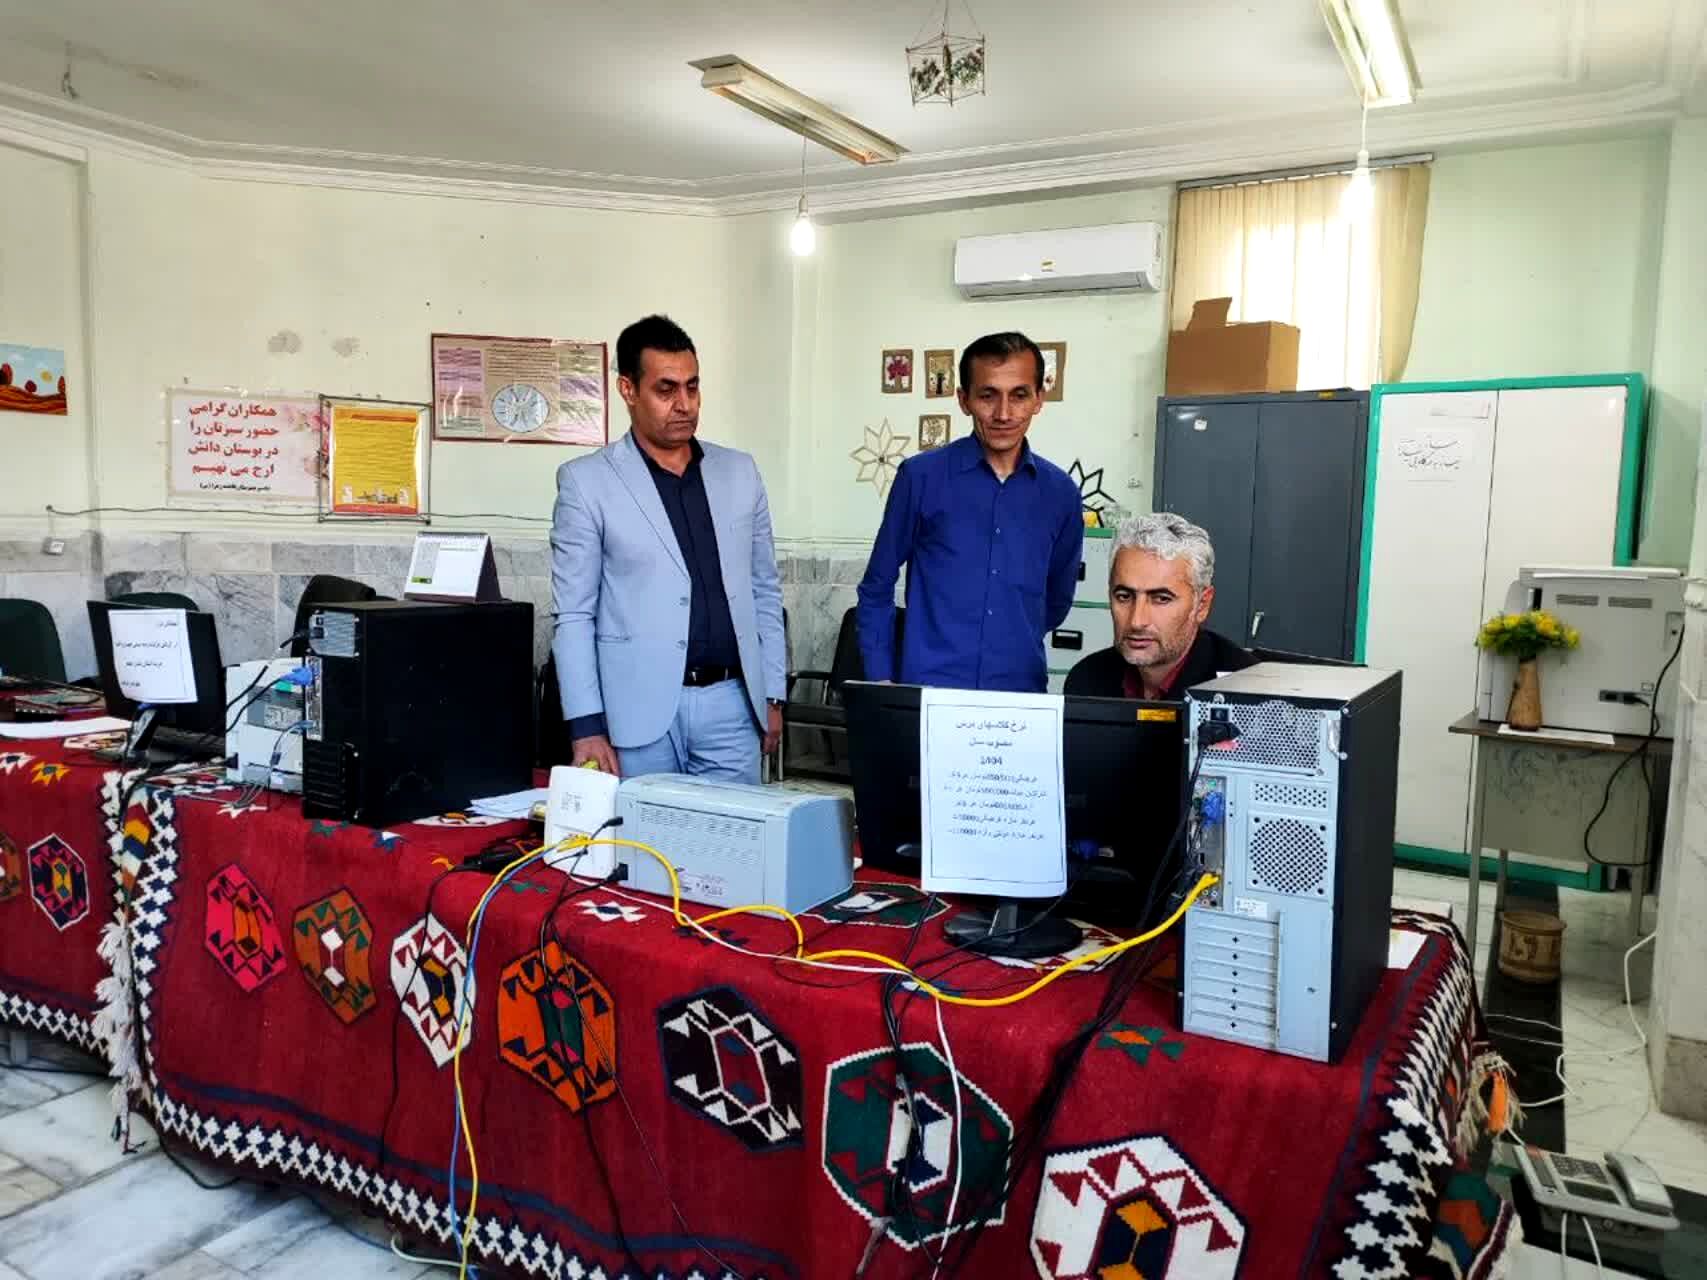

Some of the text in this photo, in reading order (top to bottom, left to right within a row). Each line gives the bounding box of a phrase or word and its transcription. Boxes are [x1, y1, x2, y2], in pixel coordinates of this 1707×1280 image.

[189, 401, 277, 418] همکاران گرامی
[190, 419, 202, 435] را
[246, 424, 279, 438] حضور
[188, 440, 279, 458] در بوستان دانش
[192, 462, 275, 478] ارج می نهیم
